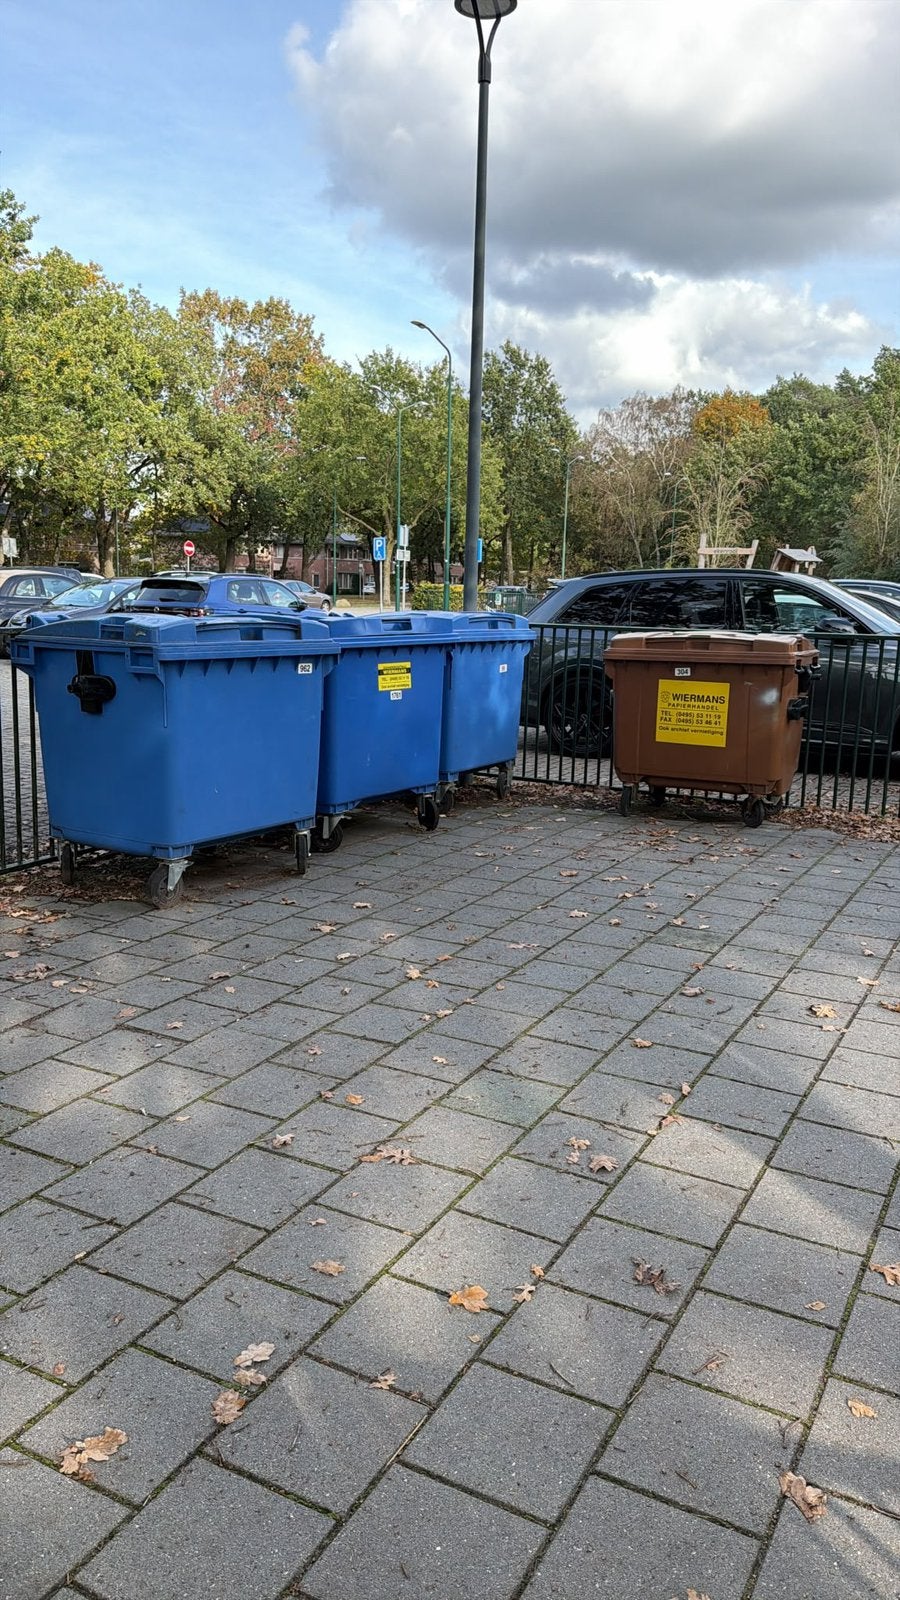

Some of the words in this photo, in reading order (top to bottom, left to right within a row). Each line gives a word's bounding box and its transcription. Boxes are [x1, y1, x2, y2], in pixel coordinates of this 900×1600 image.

[376, 540, 382, 552] P
[300, 664, 311, 672] 962
[672, 694, 726, 704] WIERMANS
